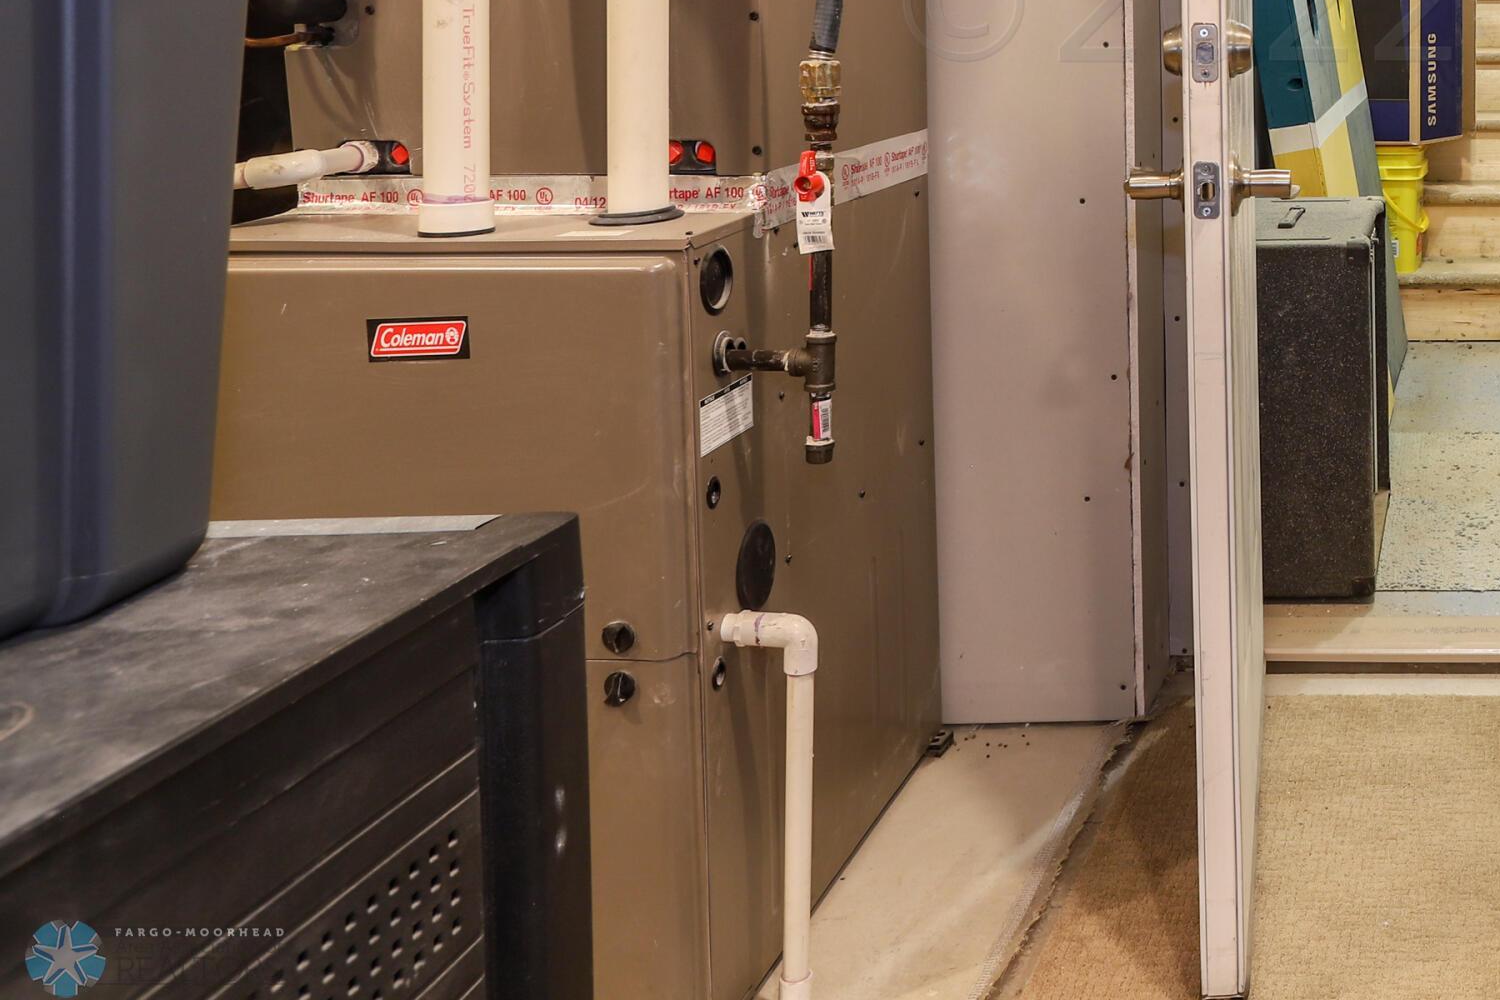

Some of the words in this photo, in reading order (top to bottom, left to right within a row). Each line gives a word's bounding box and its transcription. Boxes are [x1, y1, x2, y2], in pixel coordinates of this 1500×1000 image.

[1427, 33, 1437, 127] SAMSUNG
[303, 191, 355, 205] Shurtape
[361, 192, 376, 203] AF
[381, 191, 399, 203] 100
[507, 189, 526, 201] 100
[574, 197, 607, 209] 04/12
[705, 187, 720, 199] AF
[725, 186, 744, 199] 100
[380, 326, 444, 348] Coleman
